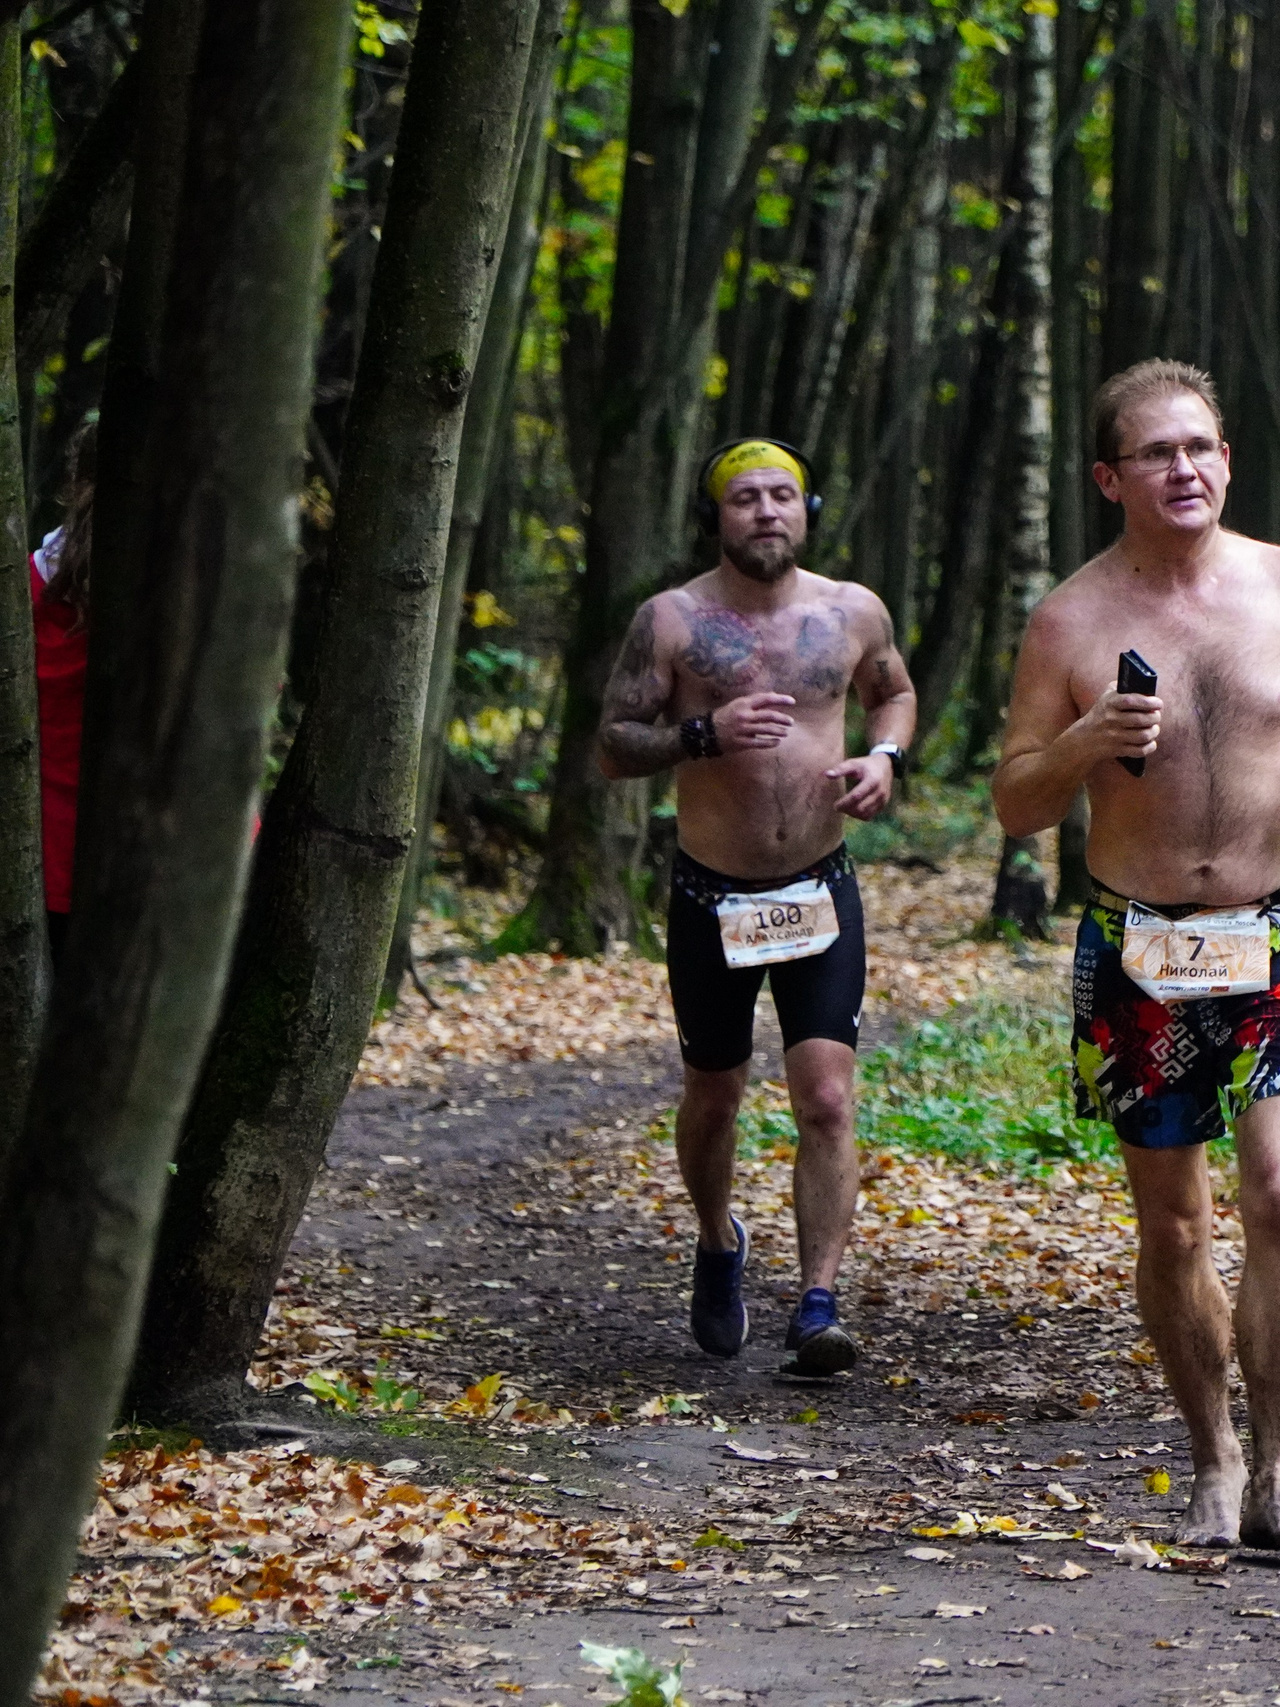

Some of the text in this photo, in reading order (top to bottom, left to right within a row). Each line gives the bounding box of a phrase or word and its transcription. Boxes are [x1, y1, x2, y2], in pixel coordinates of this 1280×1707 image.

[755, 904, 802, 929] 100
[1187, 937, 1205, 961] 7
[1159, 963, 1228, 978] Николай
